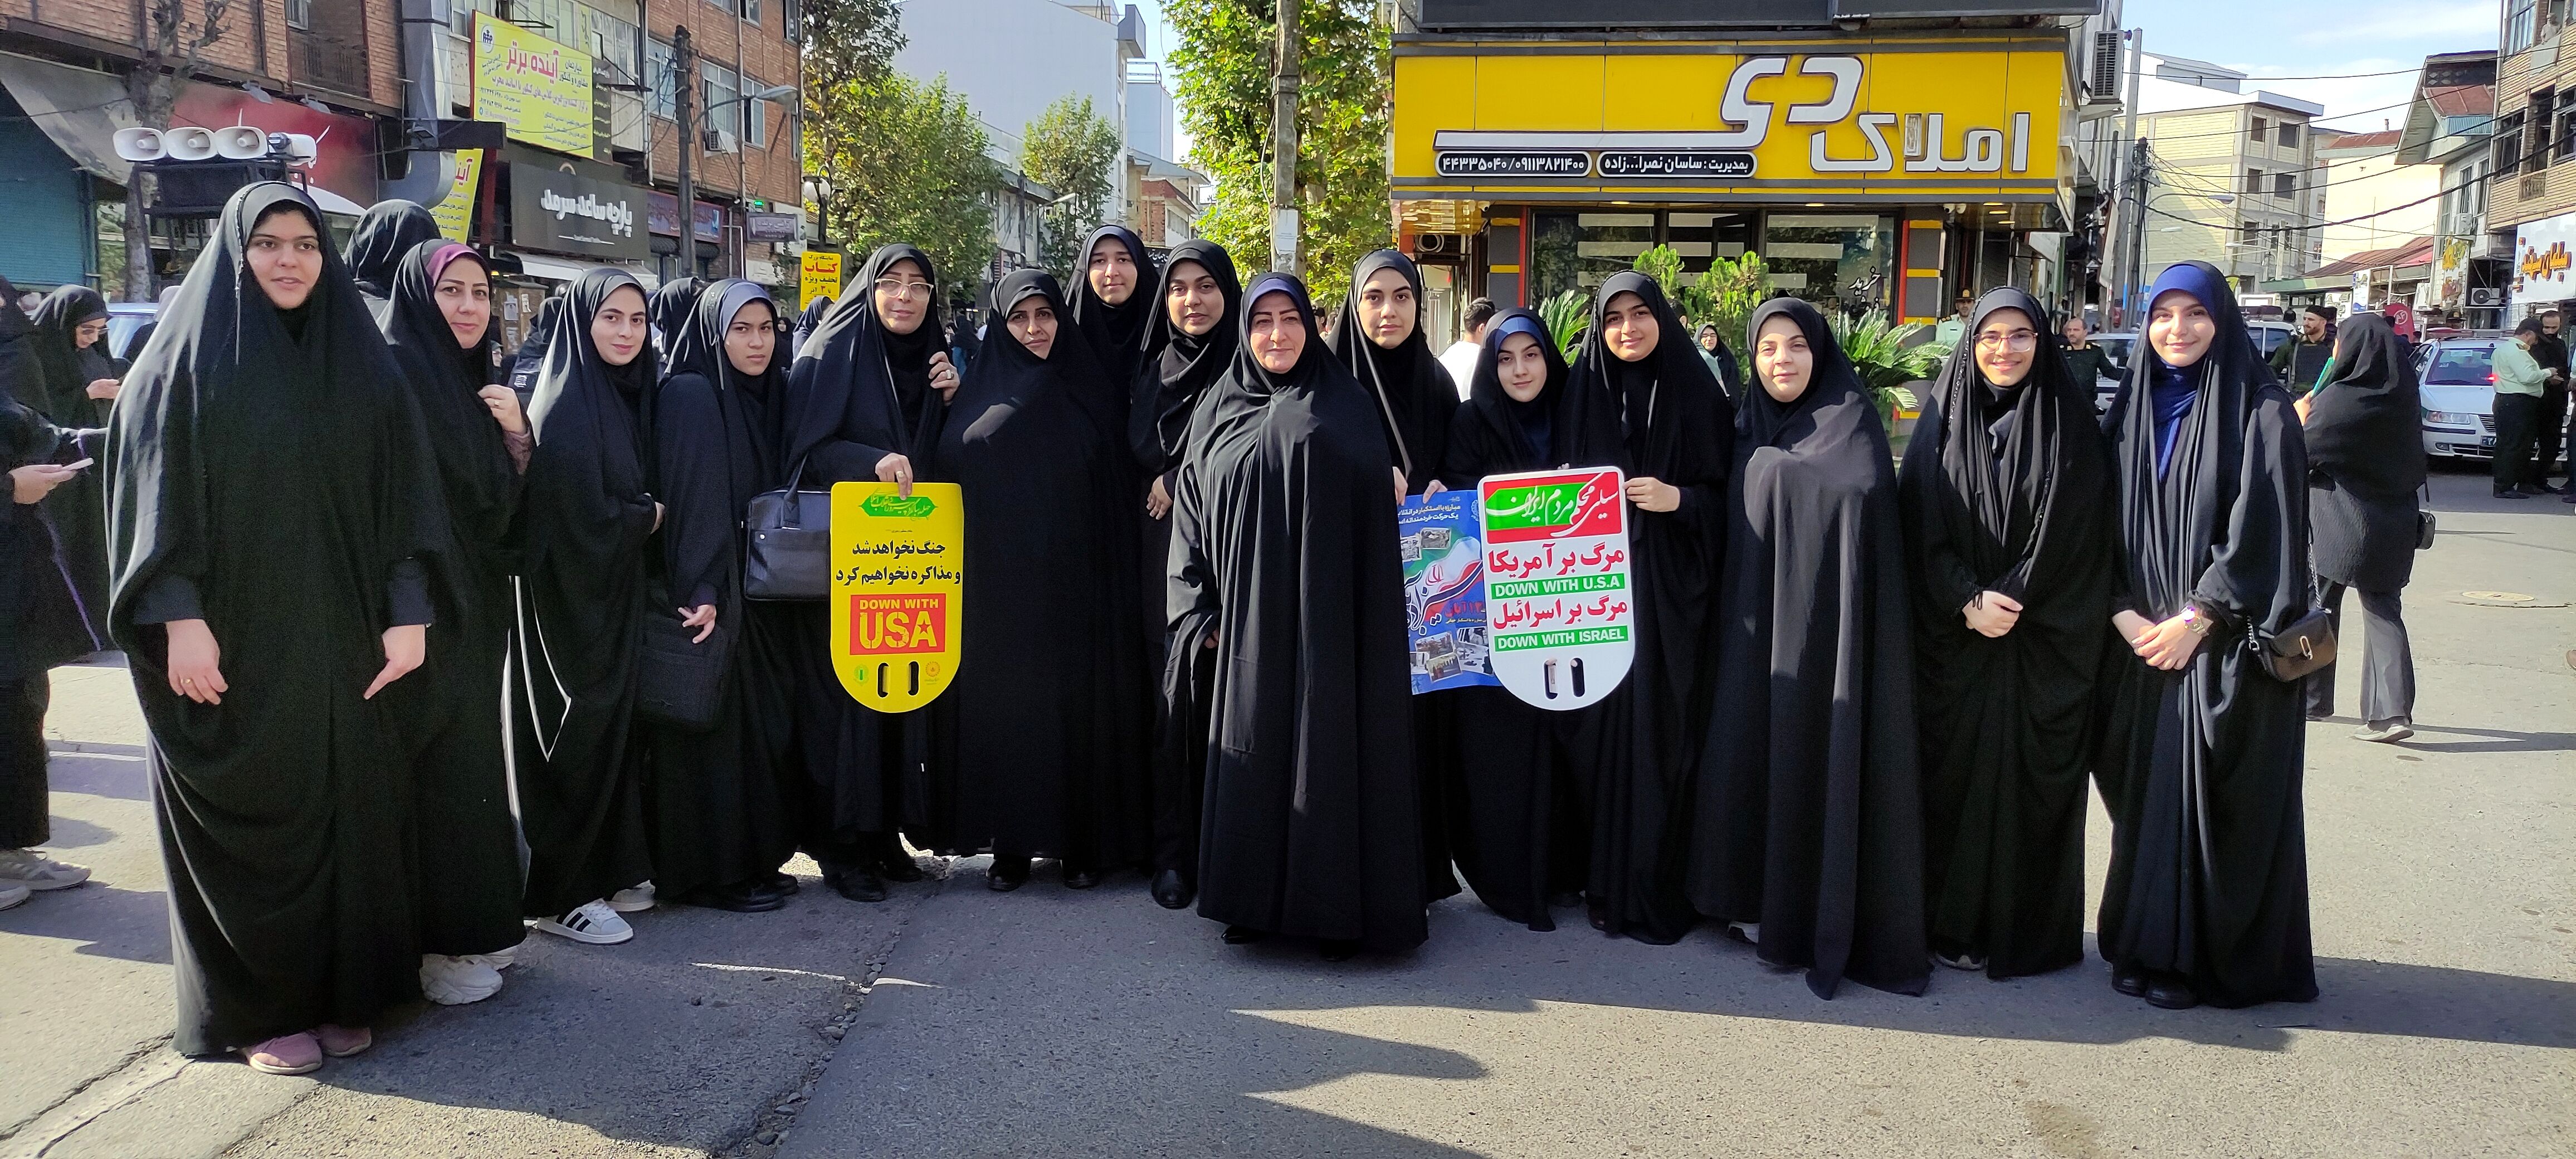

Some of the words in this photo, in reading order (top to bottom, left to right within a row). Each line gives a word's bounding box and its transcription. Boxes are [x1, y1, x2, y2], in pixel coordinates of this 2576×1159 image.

[506, 41, 527, 75] برتر
[530, 49, 559, 84] آینده
[1433, 55, 1864, 150] دی
[1809, 111, 2031, 173] املاک
[1665, 156, 1702, 173] ساسان
[540, 189, 575, 221] سرمد
[607, 201, 632, 238] پارچه
[805, 261, 838, 273] کتاب
[1848, 266, 1881, 296] خرید
[1485, 485, 1545, 523] ایران
[1545, 489, 1573, 525] مردم
[1550, 489, 1618, 537] سیلی
[1570, 473, 1604, 525] محکم
[852, 540, 871, 554] شد
[872, 540, 915, 559] نخواهد
[916, 540, 945, 558] جنگ
[1488, 543, 1556, 578] آمریکا
[1580, 542, 1624, 572] مرگ
[836, 566, 860, 586] کرد
[861, 566, 909, 585] نخواهیم
[911, 565, 952, 585] مذاکره
[954, 571, 961, 584] و
[1557, 551, 1576, 576] بر
[1495, 581, 1538, 597] DOWN
[1543, 578, 1578, 593] WITH
[1583, 576, 1620, 590] U.S.A
[860, 599, 900, 610] DOWN
[904, 598, 939, 609] WITH
[1493, 598, 1561, 629] اسرائیل
[1565, 603, 1582, 624] بر
[1587, 595, 1627, 621] مرگ
[860, 611, 938, 649] USA
[1498, 635, 1538, 650] DOWN
[1541, 632, 1575, 646] WITH
[1579, 629, 1624, 642] ISRAEL
